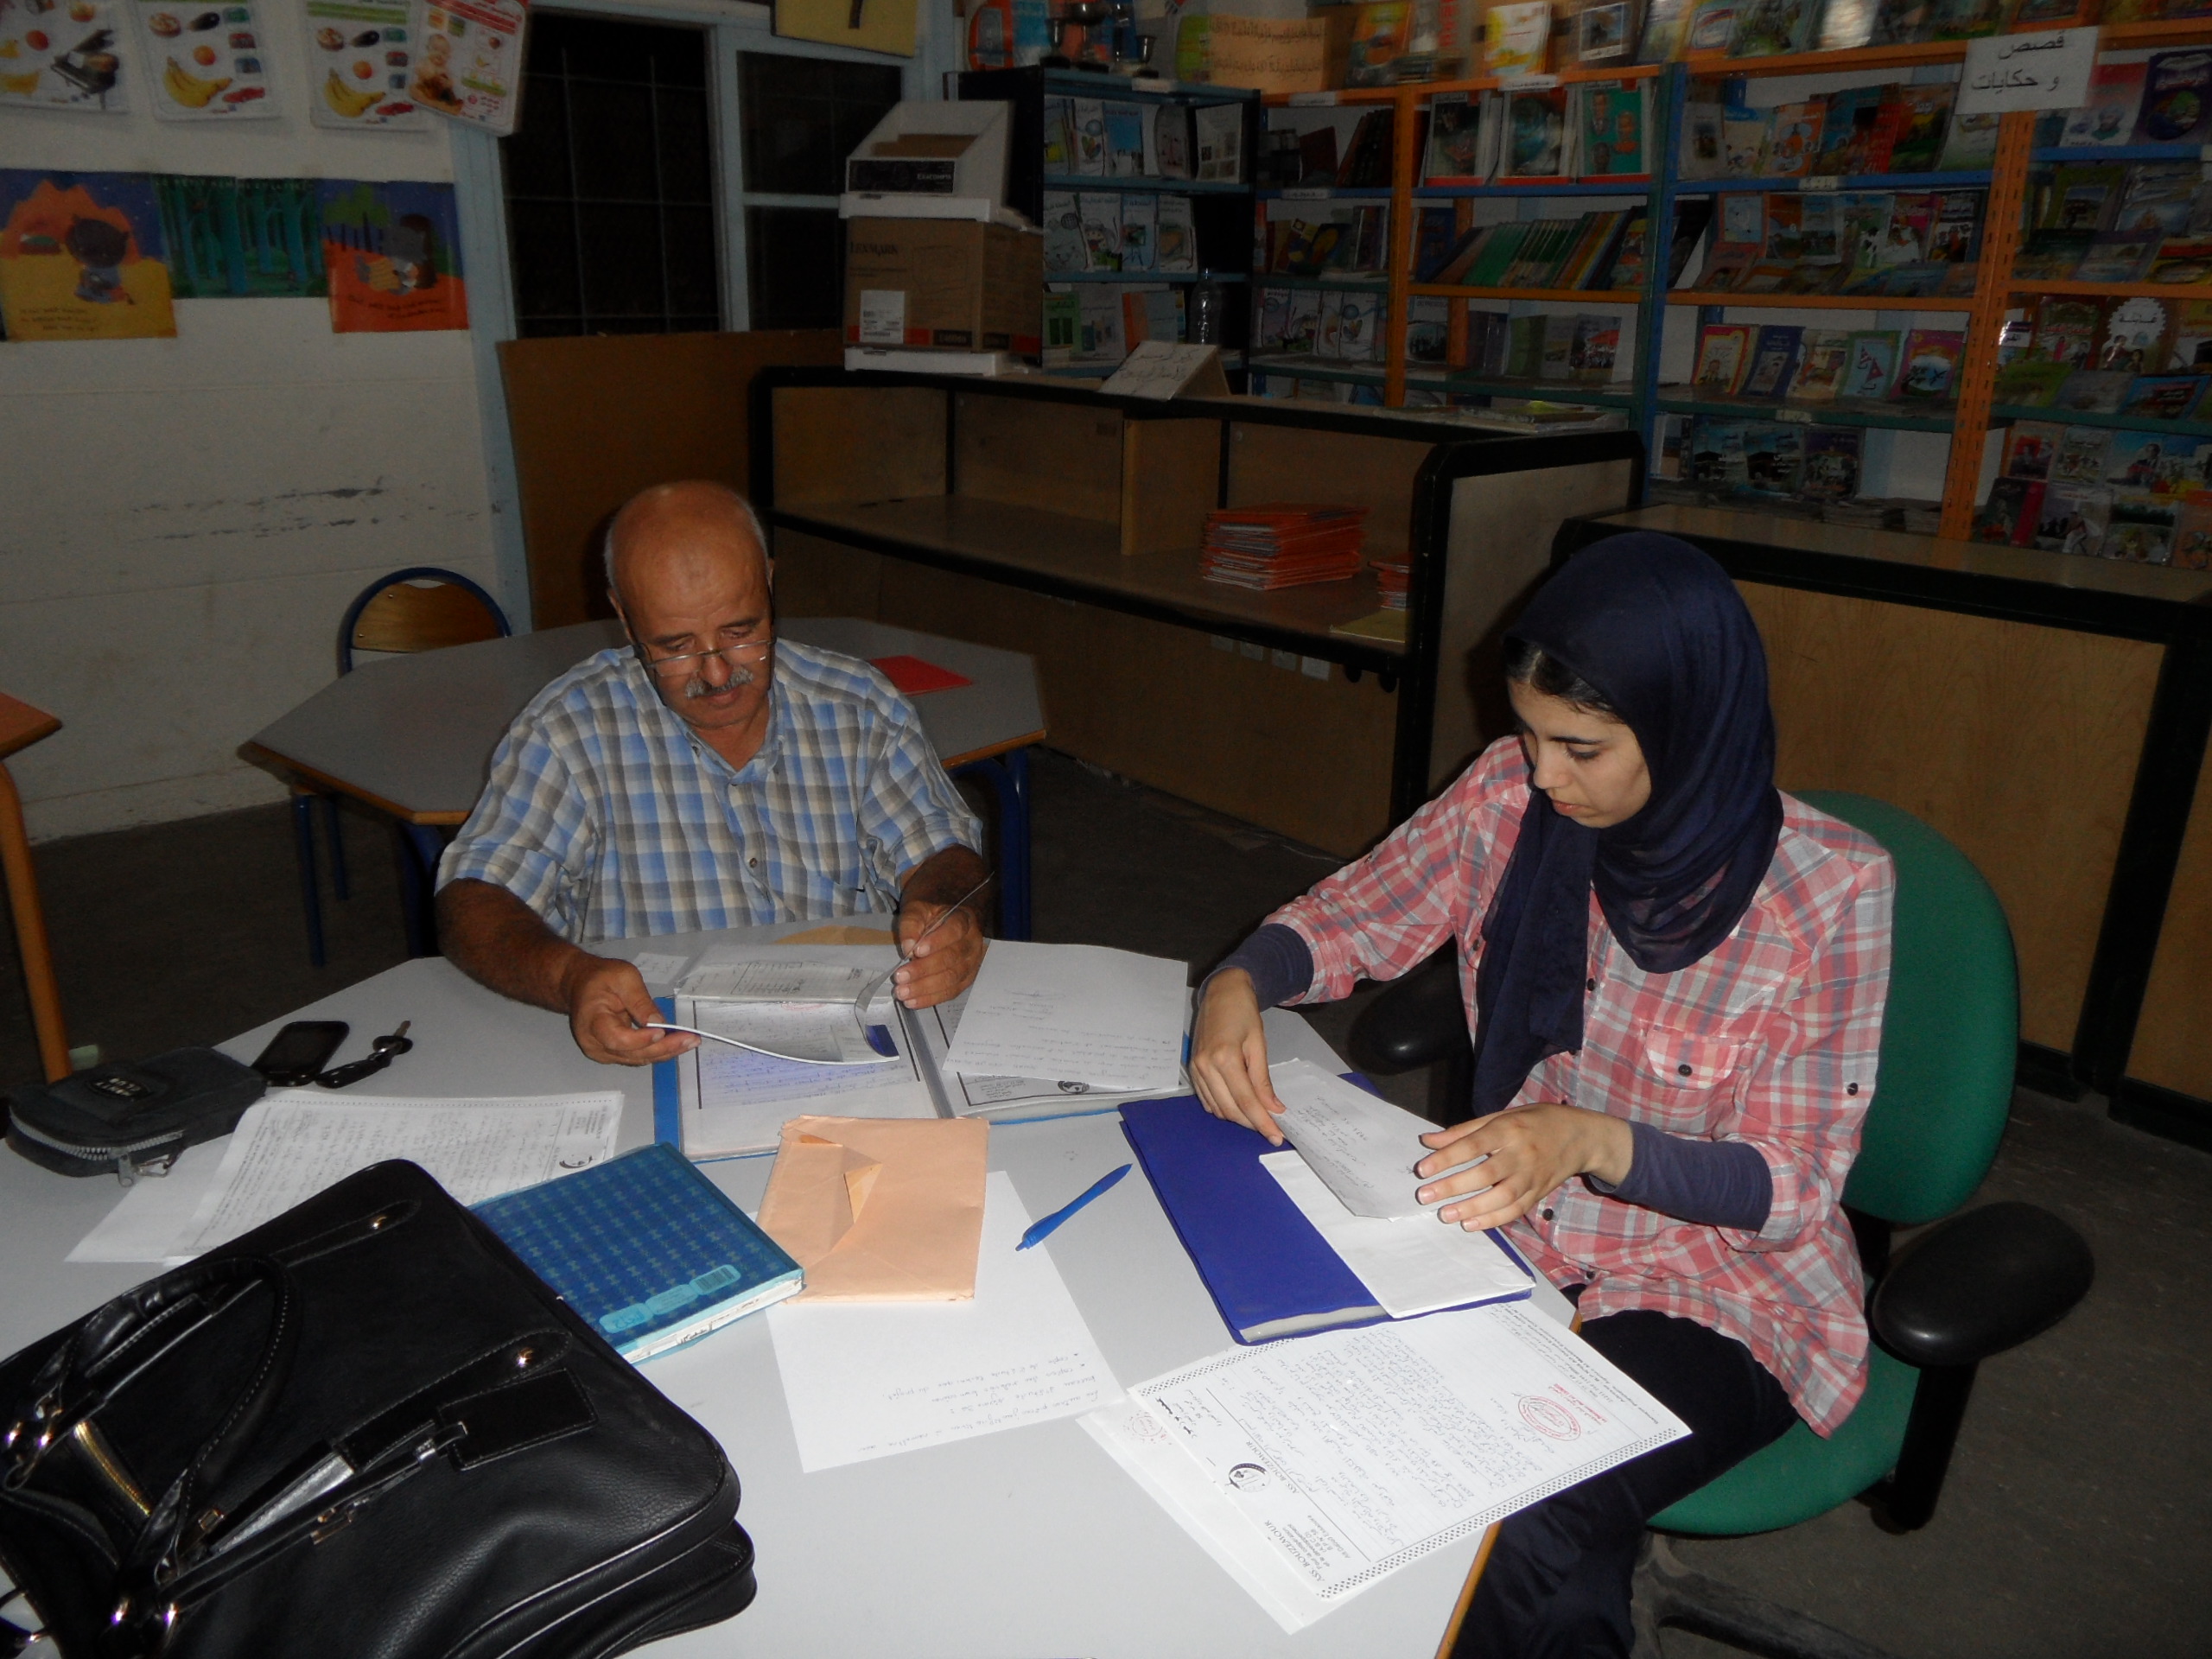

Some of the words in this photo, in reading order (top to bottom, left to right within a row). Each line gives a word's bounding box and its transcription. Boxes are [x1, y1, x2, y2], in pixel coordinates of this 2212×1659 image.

[1998, 32, 2064, 60] قصص
[1971, 68, 2038, 94] حكايات
[2046, 74, 2060, 92] و
[849, 242, 899, 257] LEXMARK
[1243, 1440, 1287, 1481] BOUZEMOUR
[1262, 1519, 1311, 1567] BOUZEMOUR
